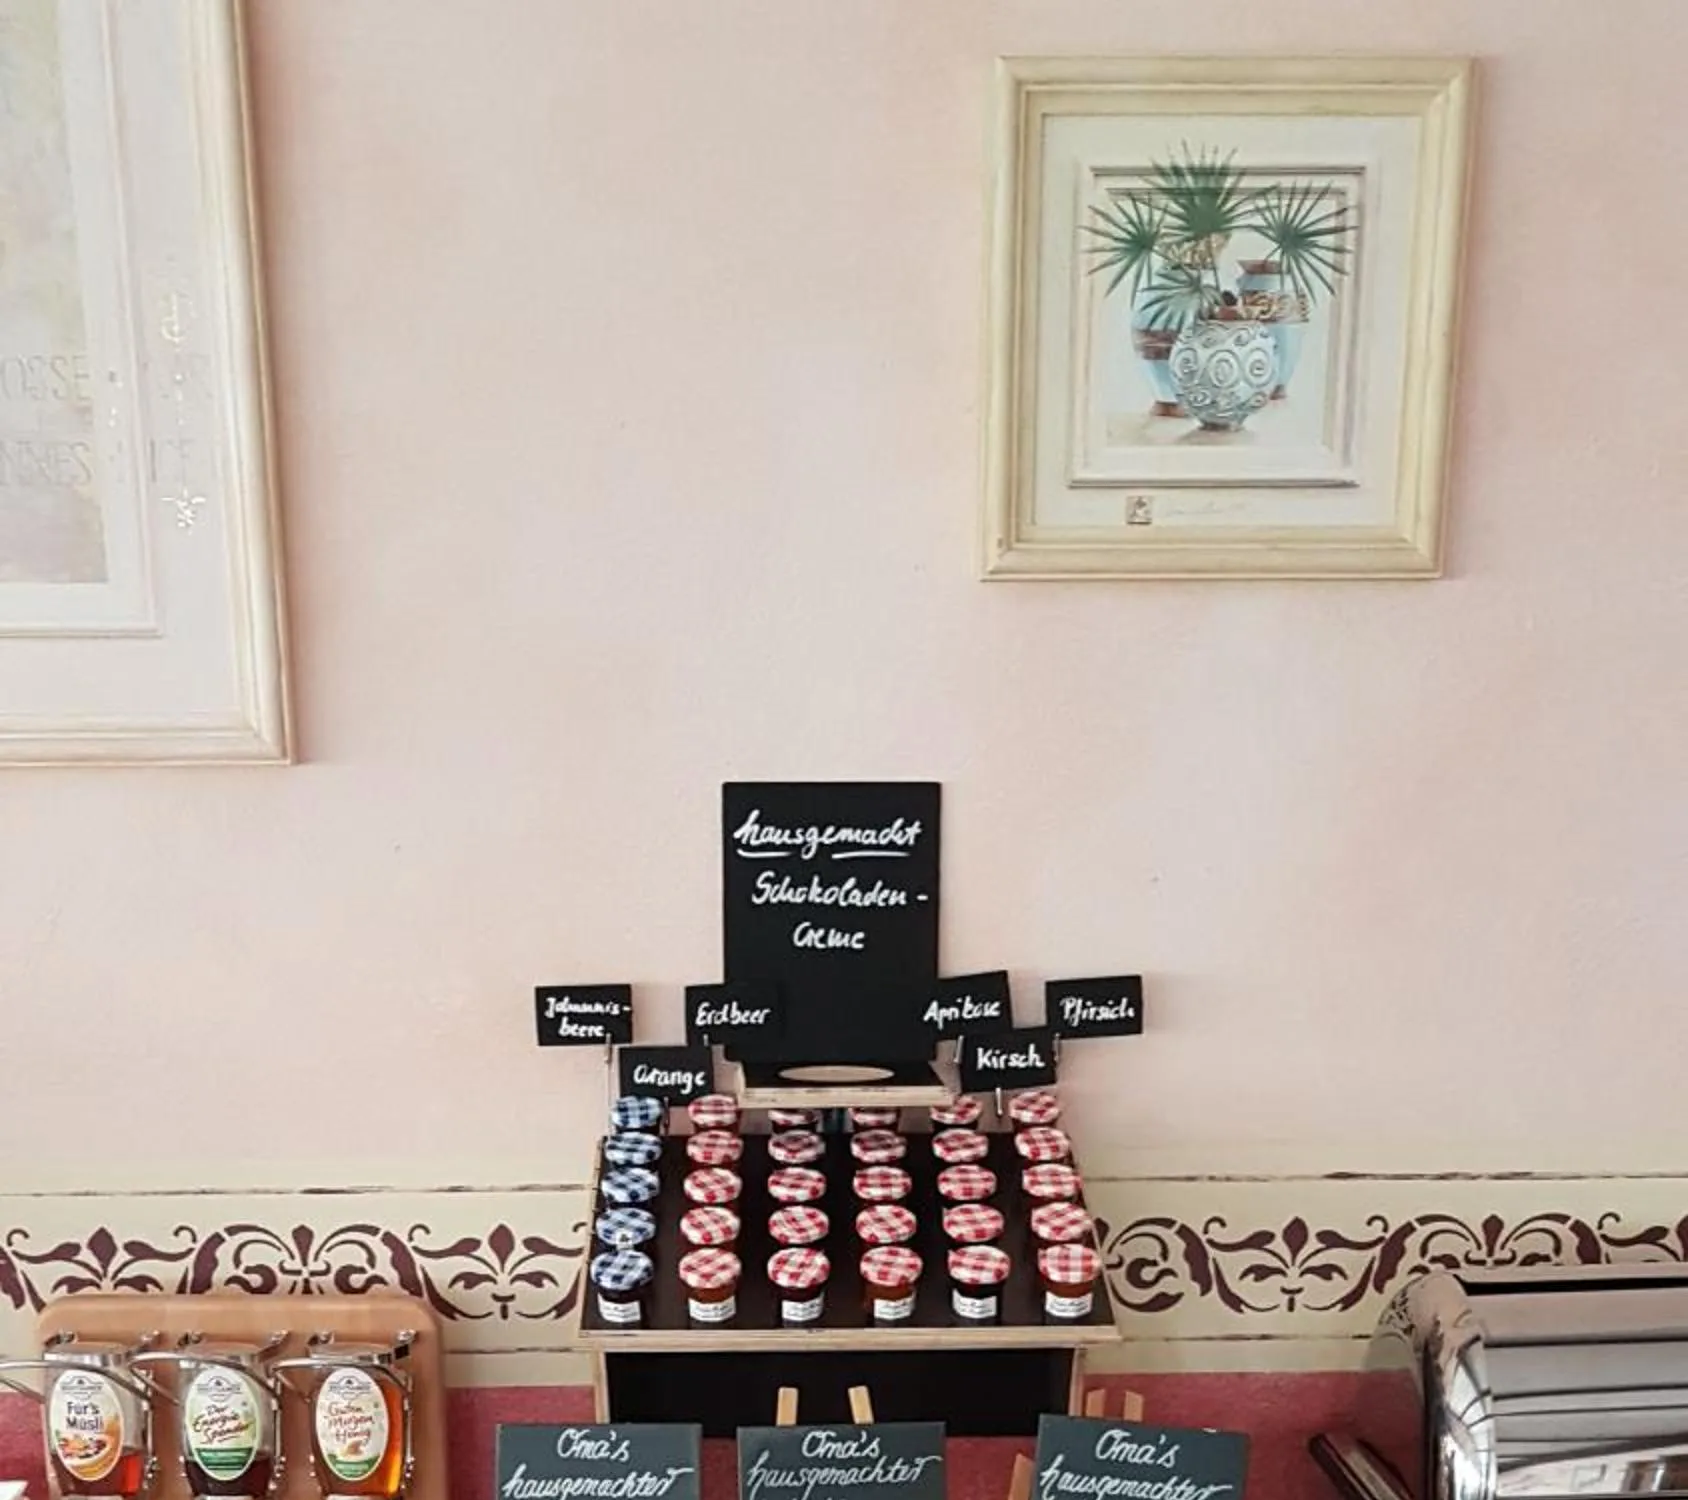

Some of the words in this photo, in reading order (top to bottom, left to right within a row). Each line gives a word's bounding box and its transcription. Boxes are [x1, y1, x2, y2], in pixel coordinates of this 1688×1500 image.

[733, 809, 922, 860] hausgemacht
[793, 921, 866, 949] Creme
[695, 1001, 770, 1027] Erdbeer
[923, 995, 1001, 1031] Aprikose
[1059, 997, 1135, 1027] Pfirsich
[976, 1043, 1046, 1071] Kirsch
[558, 1429, 630, 1461] Oma's
[802, 1430, 880, 1459] Oma's
[1096, 1429, 1180, 1468] Oma's
